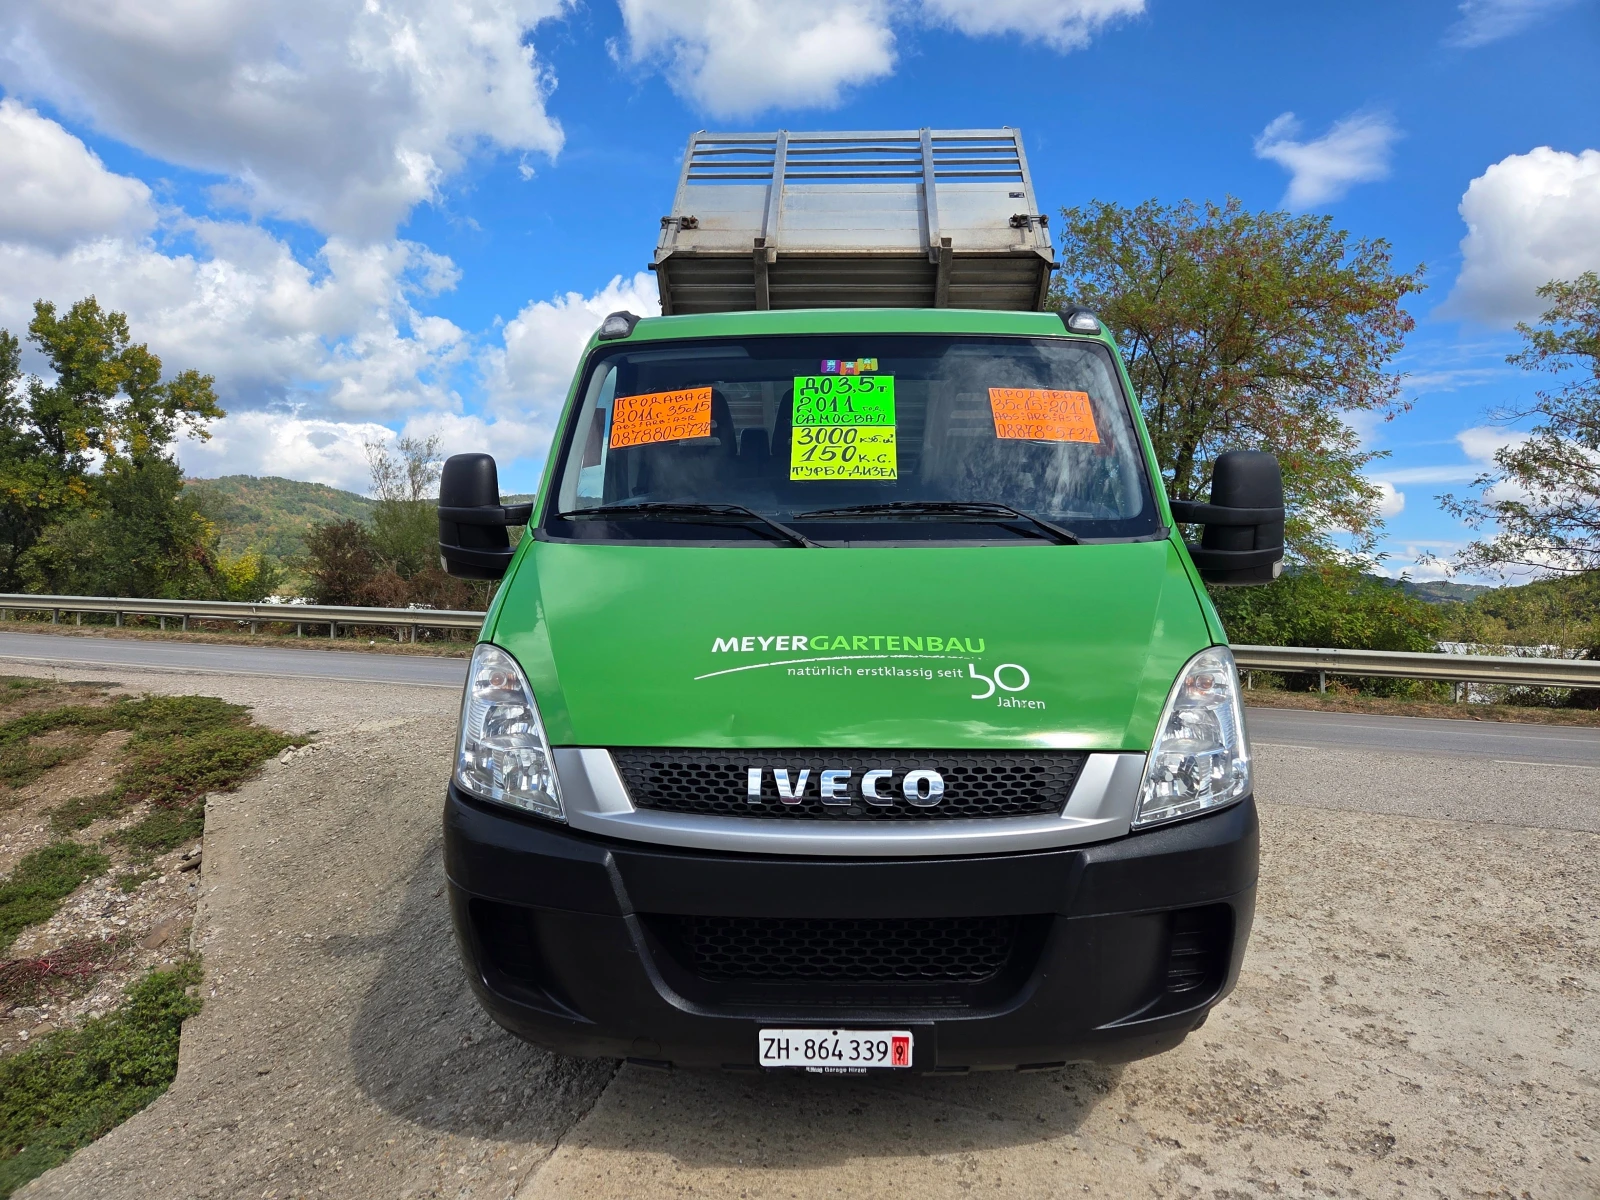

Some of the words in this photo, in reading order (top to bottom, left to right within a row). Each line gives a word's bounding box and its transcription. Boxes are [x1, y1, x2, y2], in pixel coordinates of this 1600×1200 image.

[617, 394, 694, 410] ПРОДАВА
[796, 396, 858, 413] 2011
[796, 414, 886, 424] САМОСВАЛ
[797, 428, 858, 445] 3000
[799, 444, 857, 462] 150
[787, 665, 852, 676] natürlich
[856, 666, 933, 680] erstklassig
[938, 667, 964, 679] seit
[968, 663, 1030, 700] 50
[997, 696, 1046, 710] Jahren
[747, 767, 944, 807] IVECO
